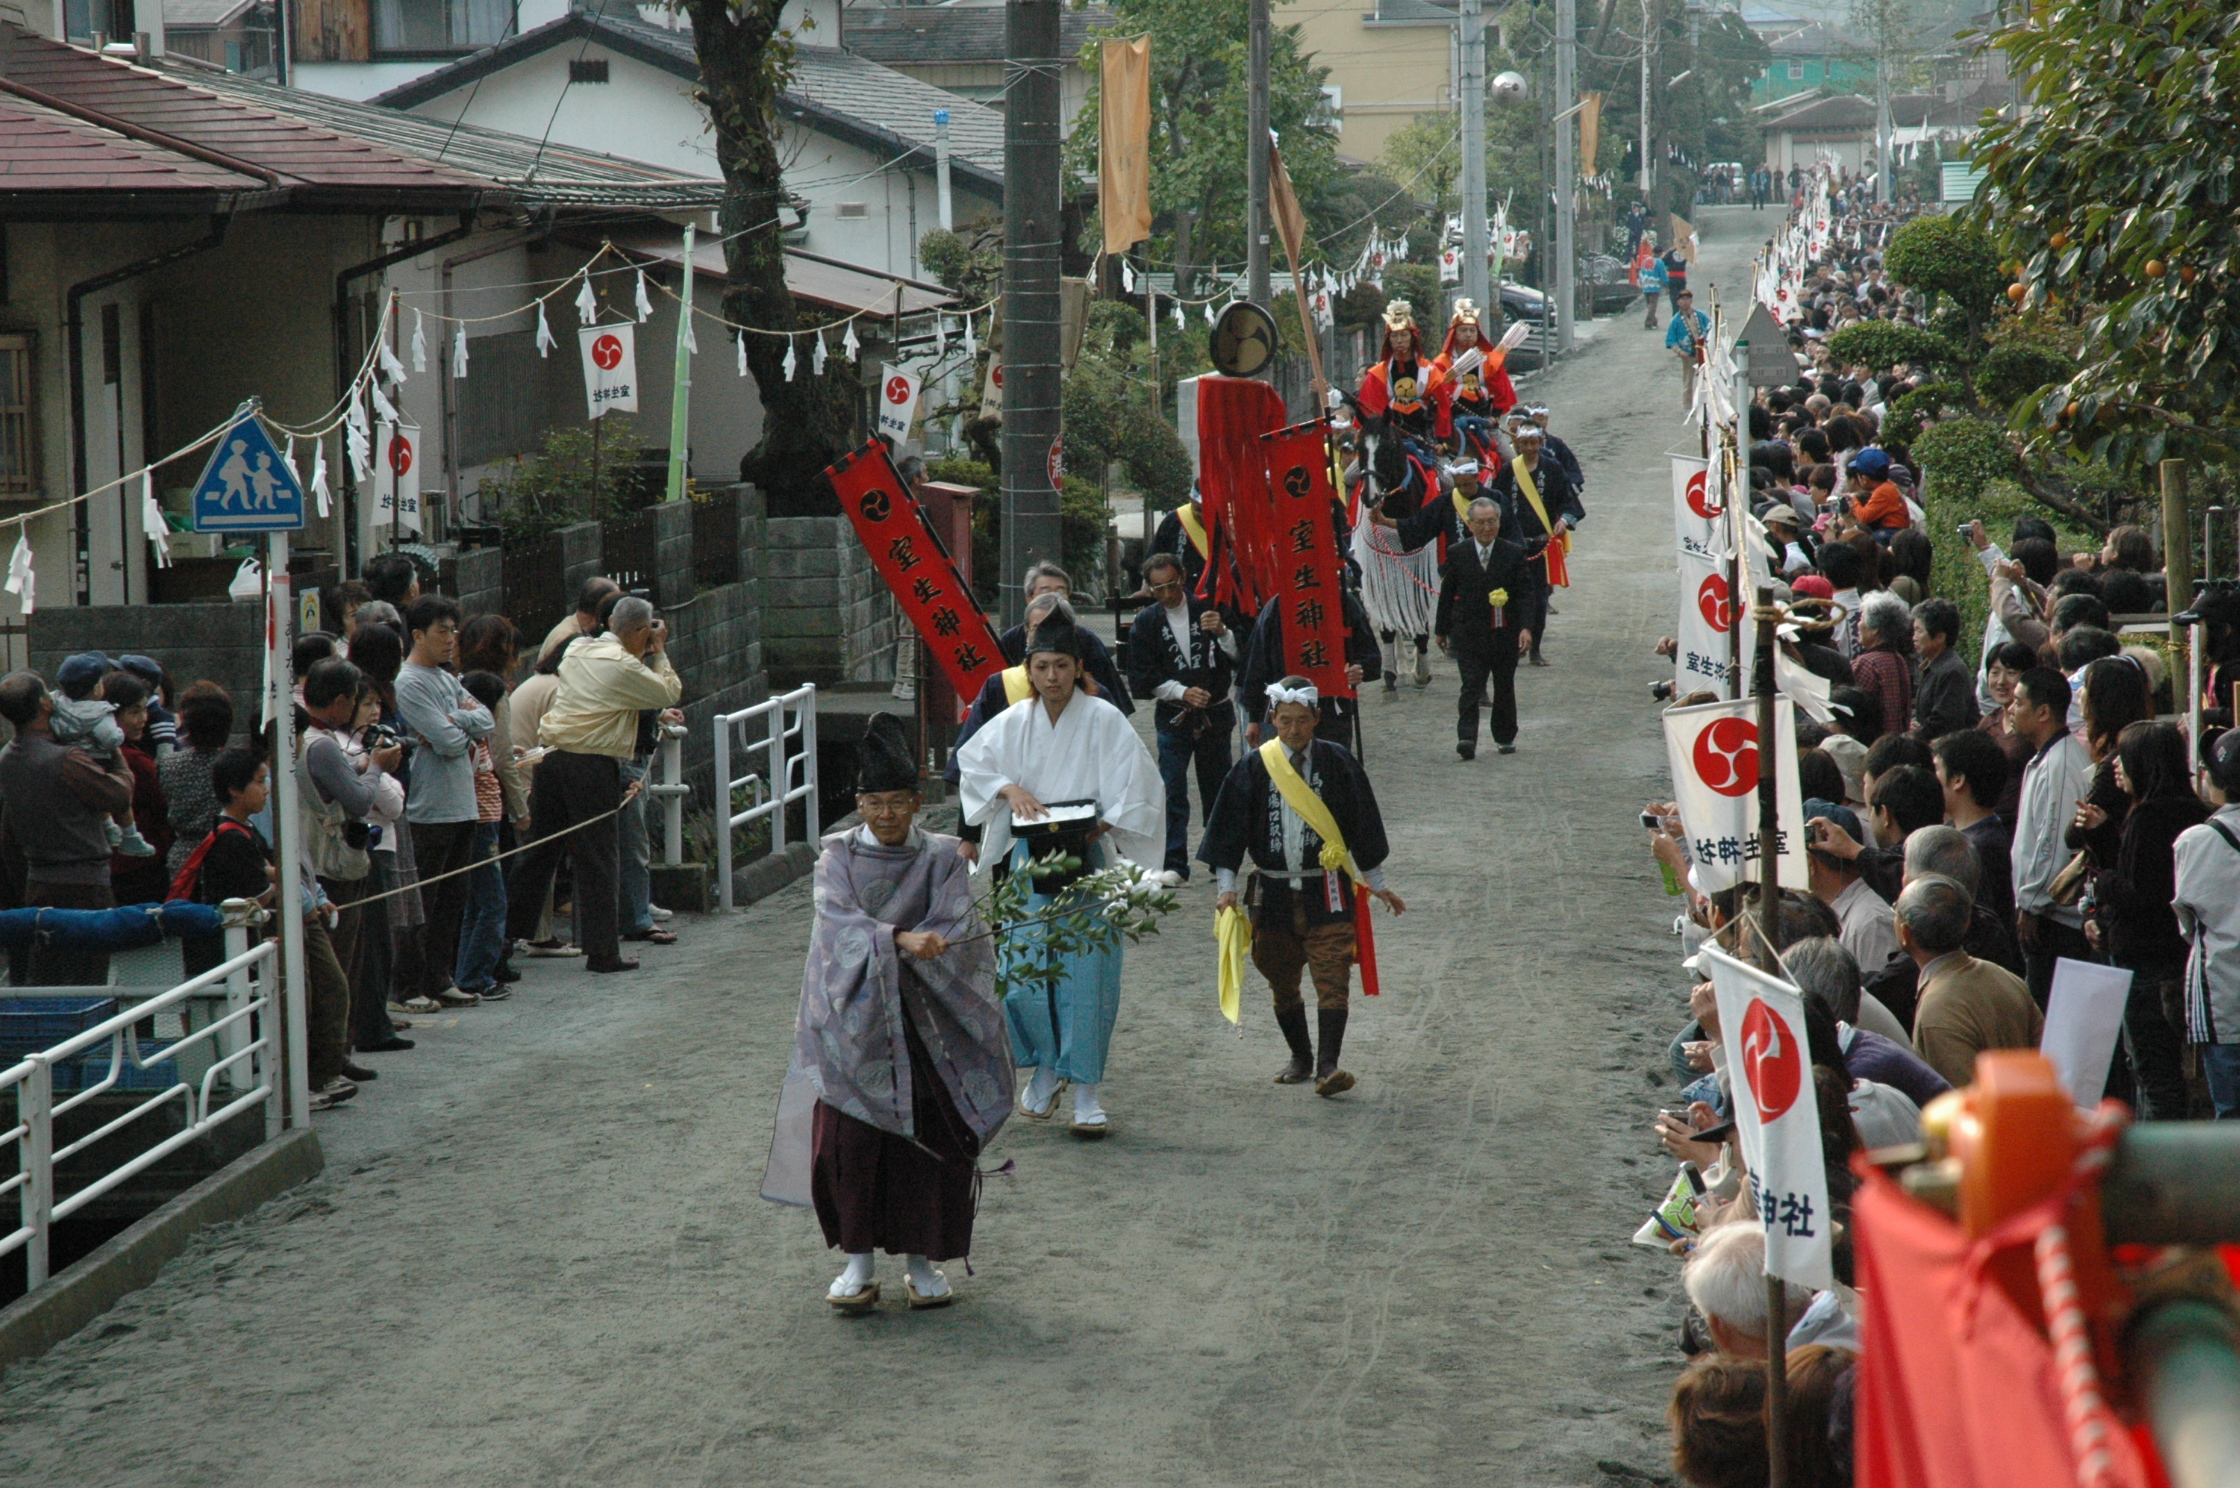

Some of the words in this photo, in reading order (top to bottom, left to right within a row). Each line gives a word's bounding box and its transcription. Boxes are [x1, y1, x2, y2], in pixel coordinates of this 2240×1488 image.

[888, 535, 987, 673] 室生神社
[1289, 518, 1331, 669] 室生神社
[1686, 651, 1732, 685] 室生神
